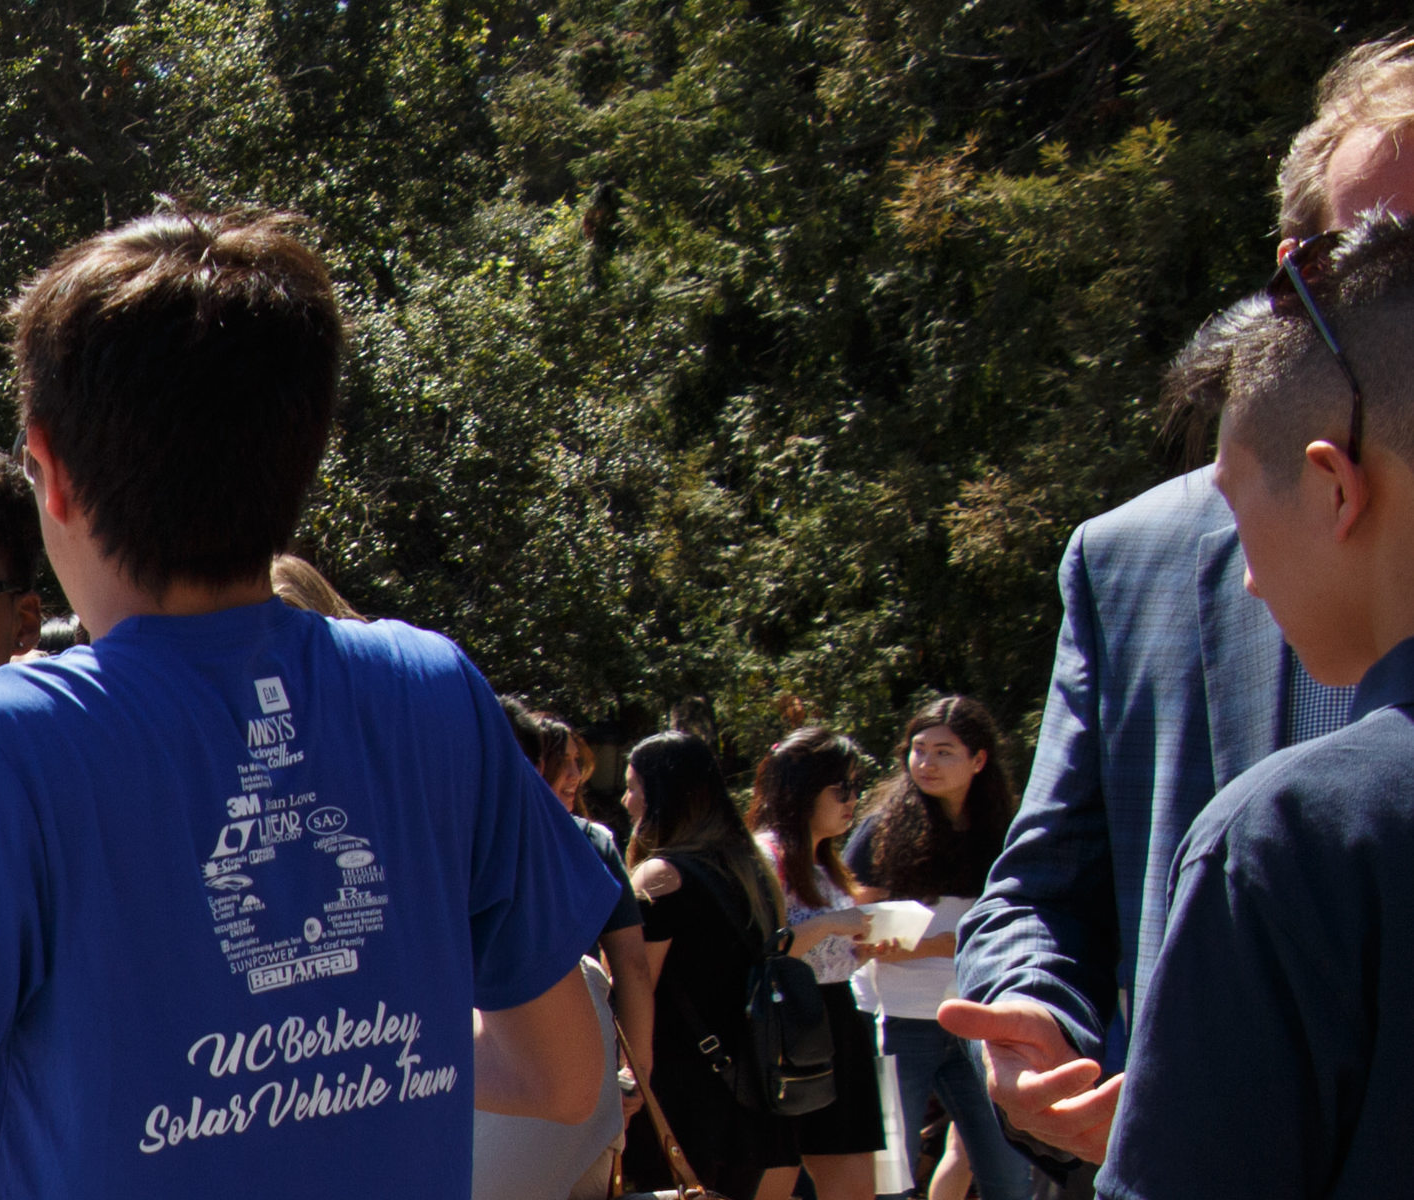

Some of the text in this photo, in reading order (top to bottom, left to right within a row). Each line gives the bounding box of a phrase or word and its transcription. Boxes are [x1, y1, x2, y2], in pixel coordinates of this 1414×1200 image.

[262, 685, 279, 700] GM
[247, 712, 296, 748] ANSYS
[226, 794, 261, 818] 3M
[289, 791, 317, 807] Love
[187, 1000, 422, 1078] UC Berkeley
[139, 1055, 458, 1154] Solar Vehicle Team
